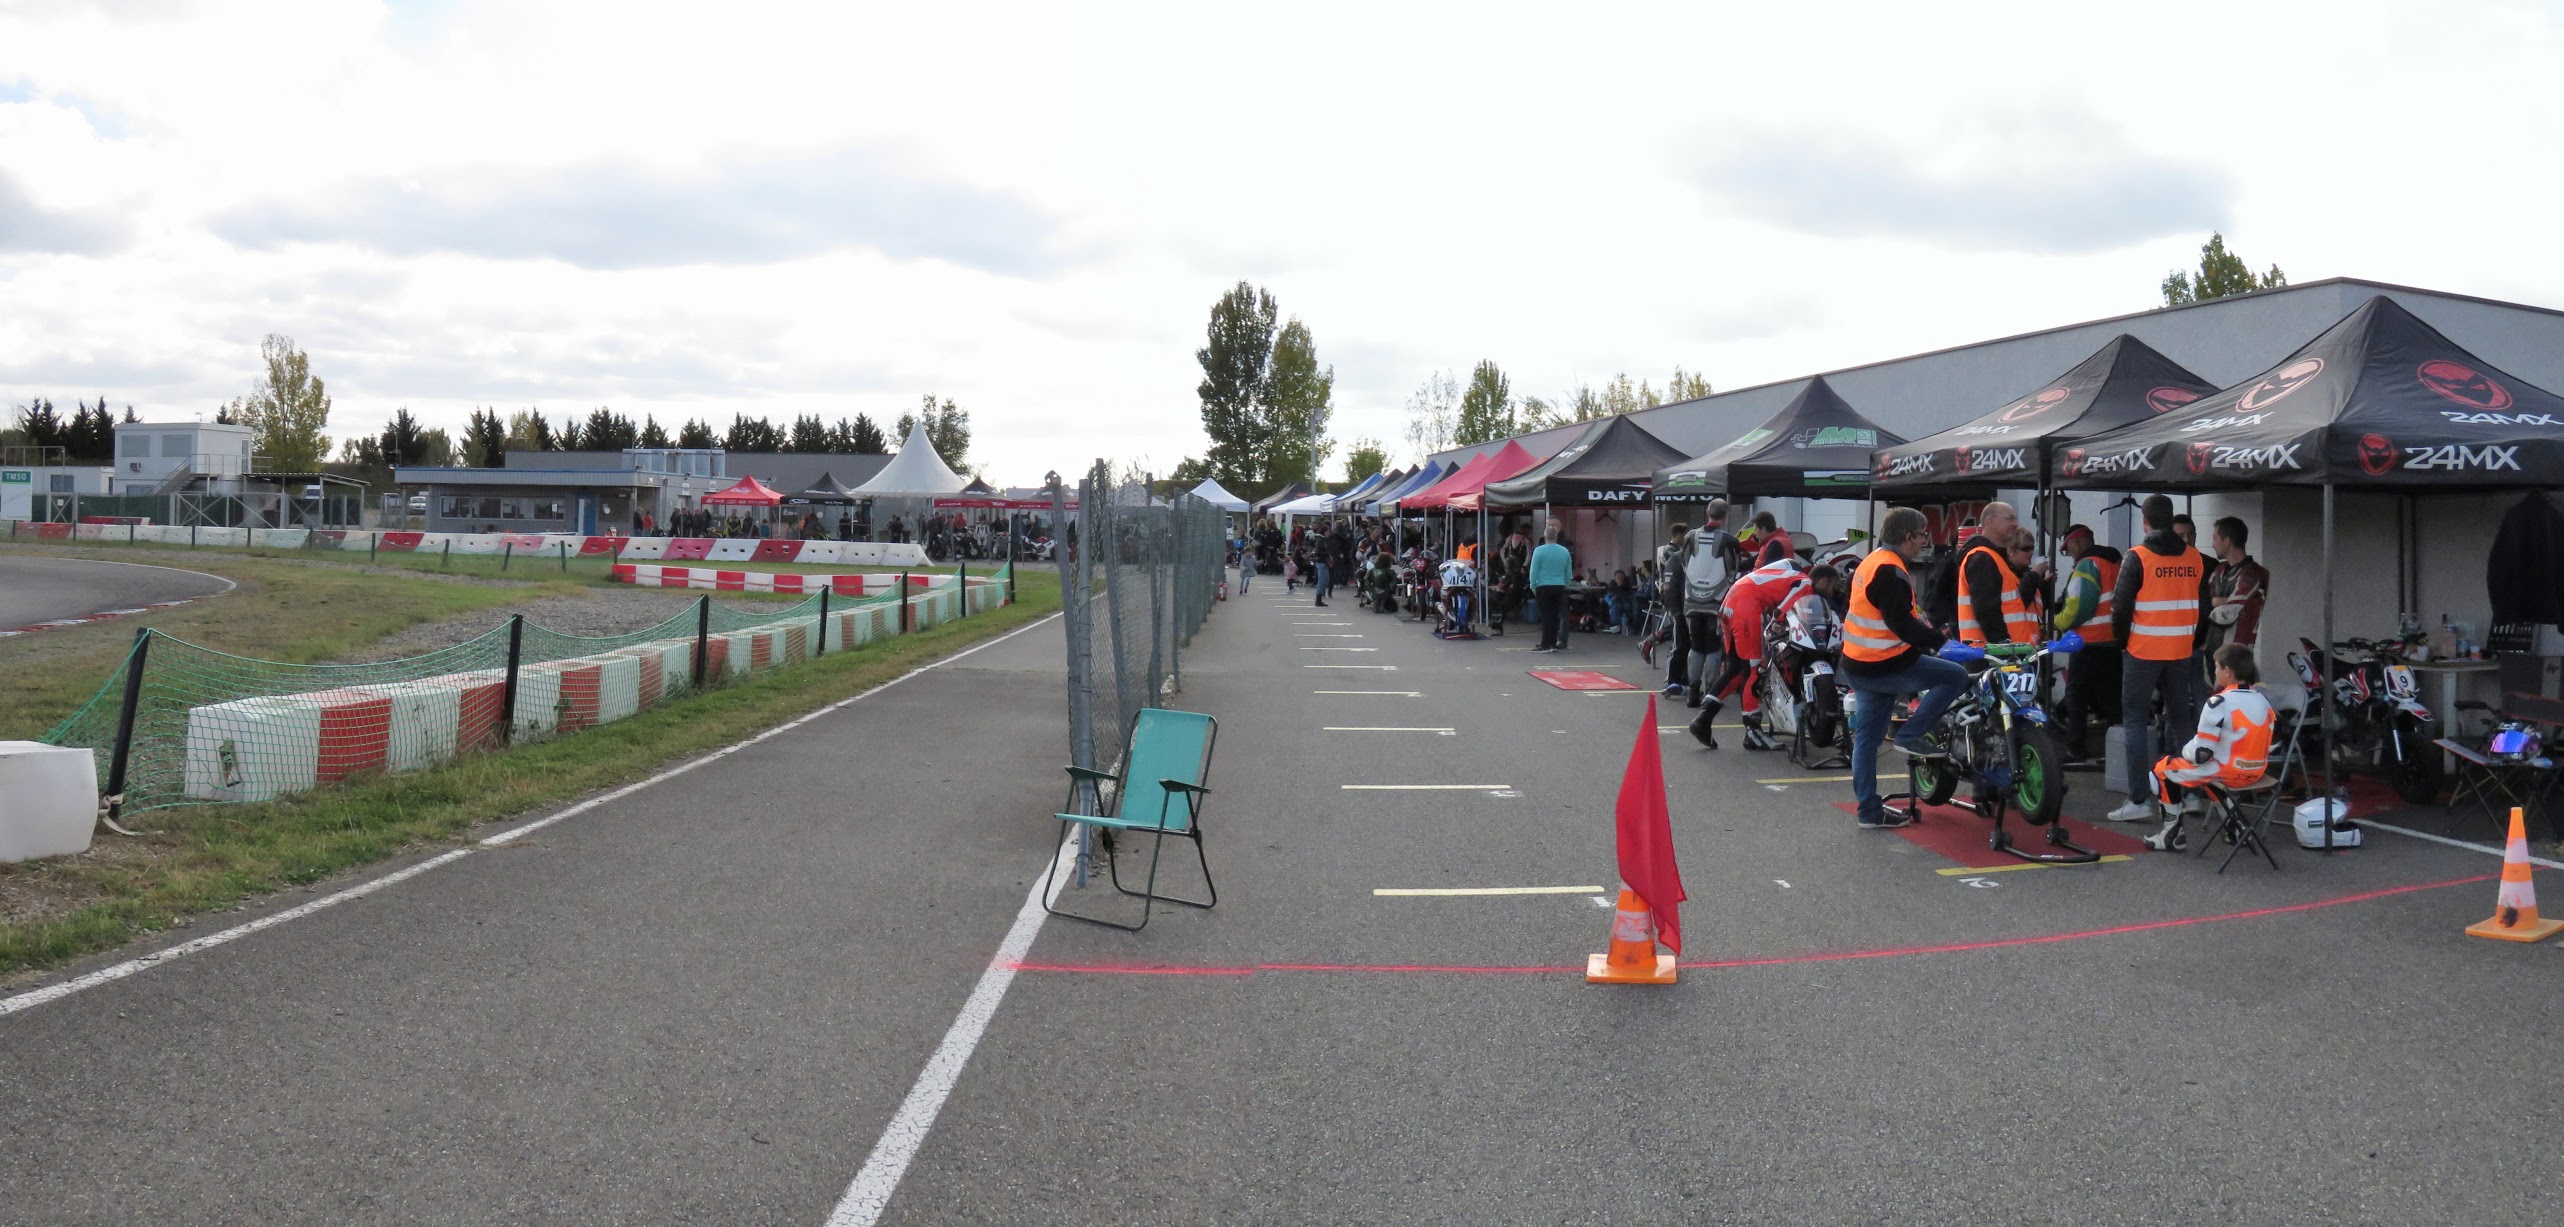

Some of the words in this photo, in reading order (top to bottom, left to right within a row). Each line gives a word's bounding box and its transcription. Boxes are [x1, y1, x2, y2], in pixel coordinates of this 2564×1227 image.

[2440, 411, 2564, 426] 24MX
[1890, 453, 1934, 477] 24MX
[1971, 448, 2025, 470] 24MX
[2211, 443, 2301, 469] 24MX
[2403, 445, 2522, 471] 24MX
[5, 472, 26, 481] TMSO
[1588, 490, 1646, 501] DAFY
[2155, 566, 2197, 578] OFFICIEL
[1791, 622, 1808, 642] 21
[2006, 672, 2036, 693] 217
[2400, 675, 2408, 688] 9
